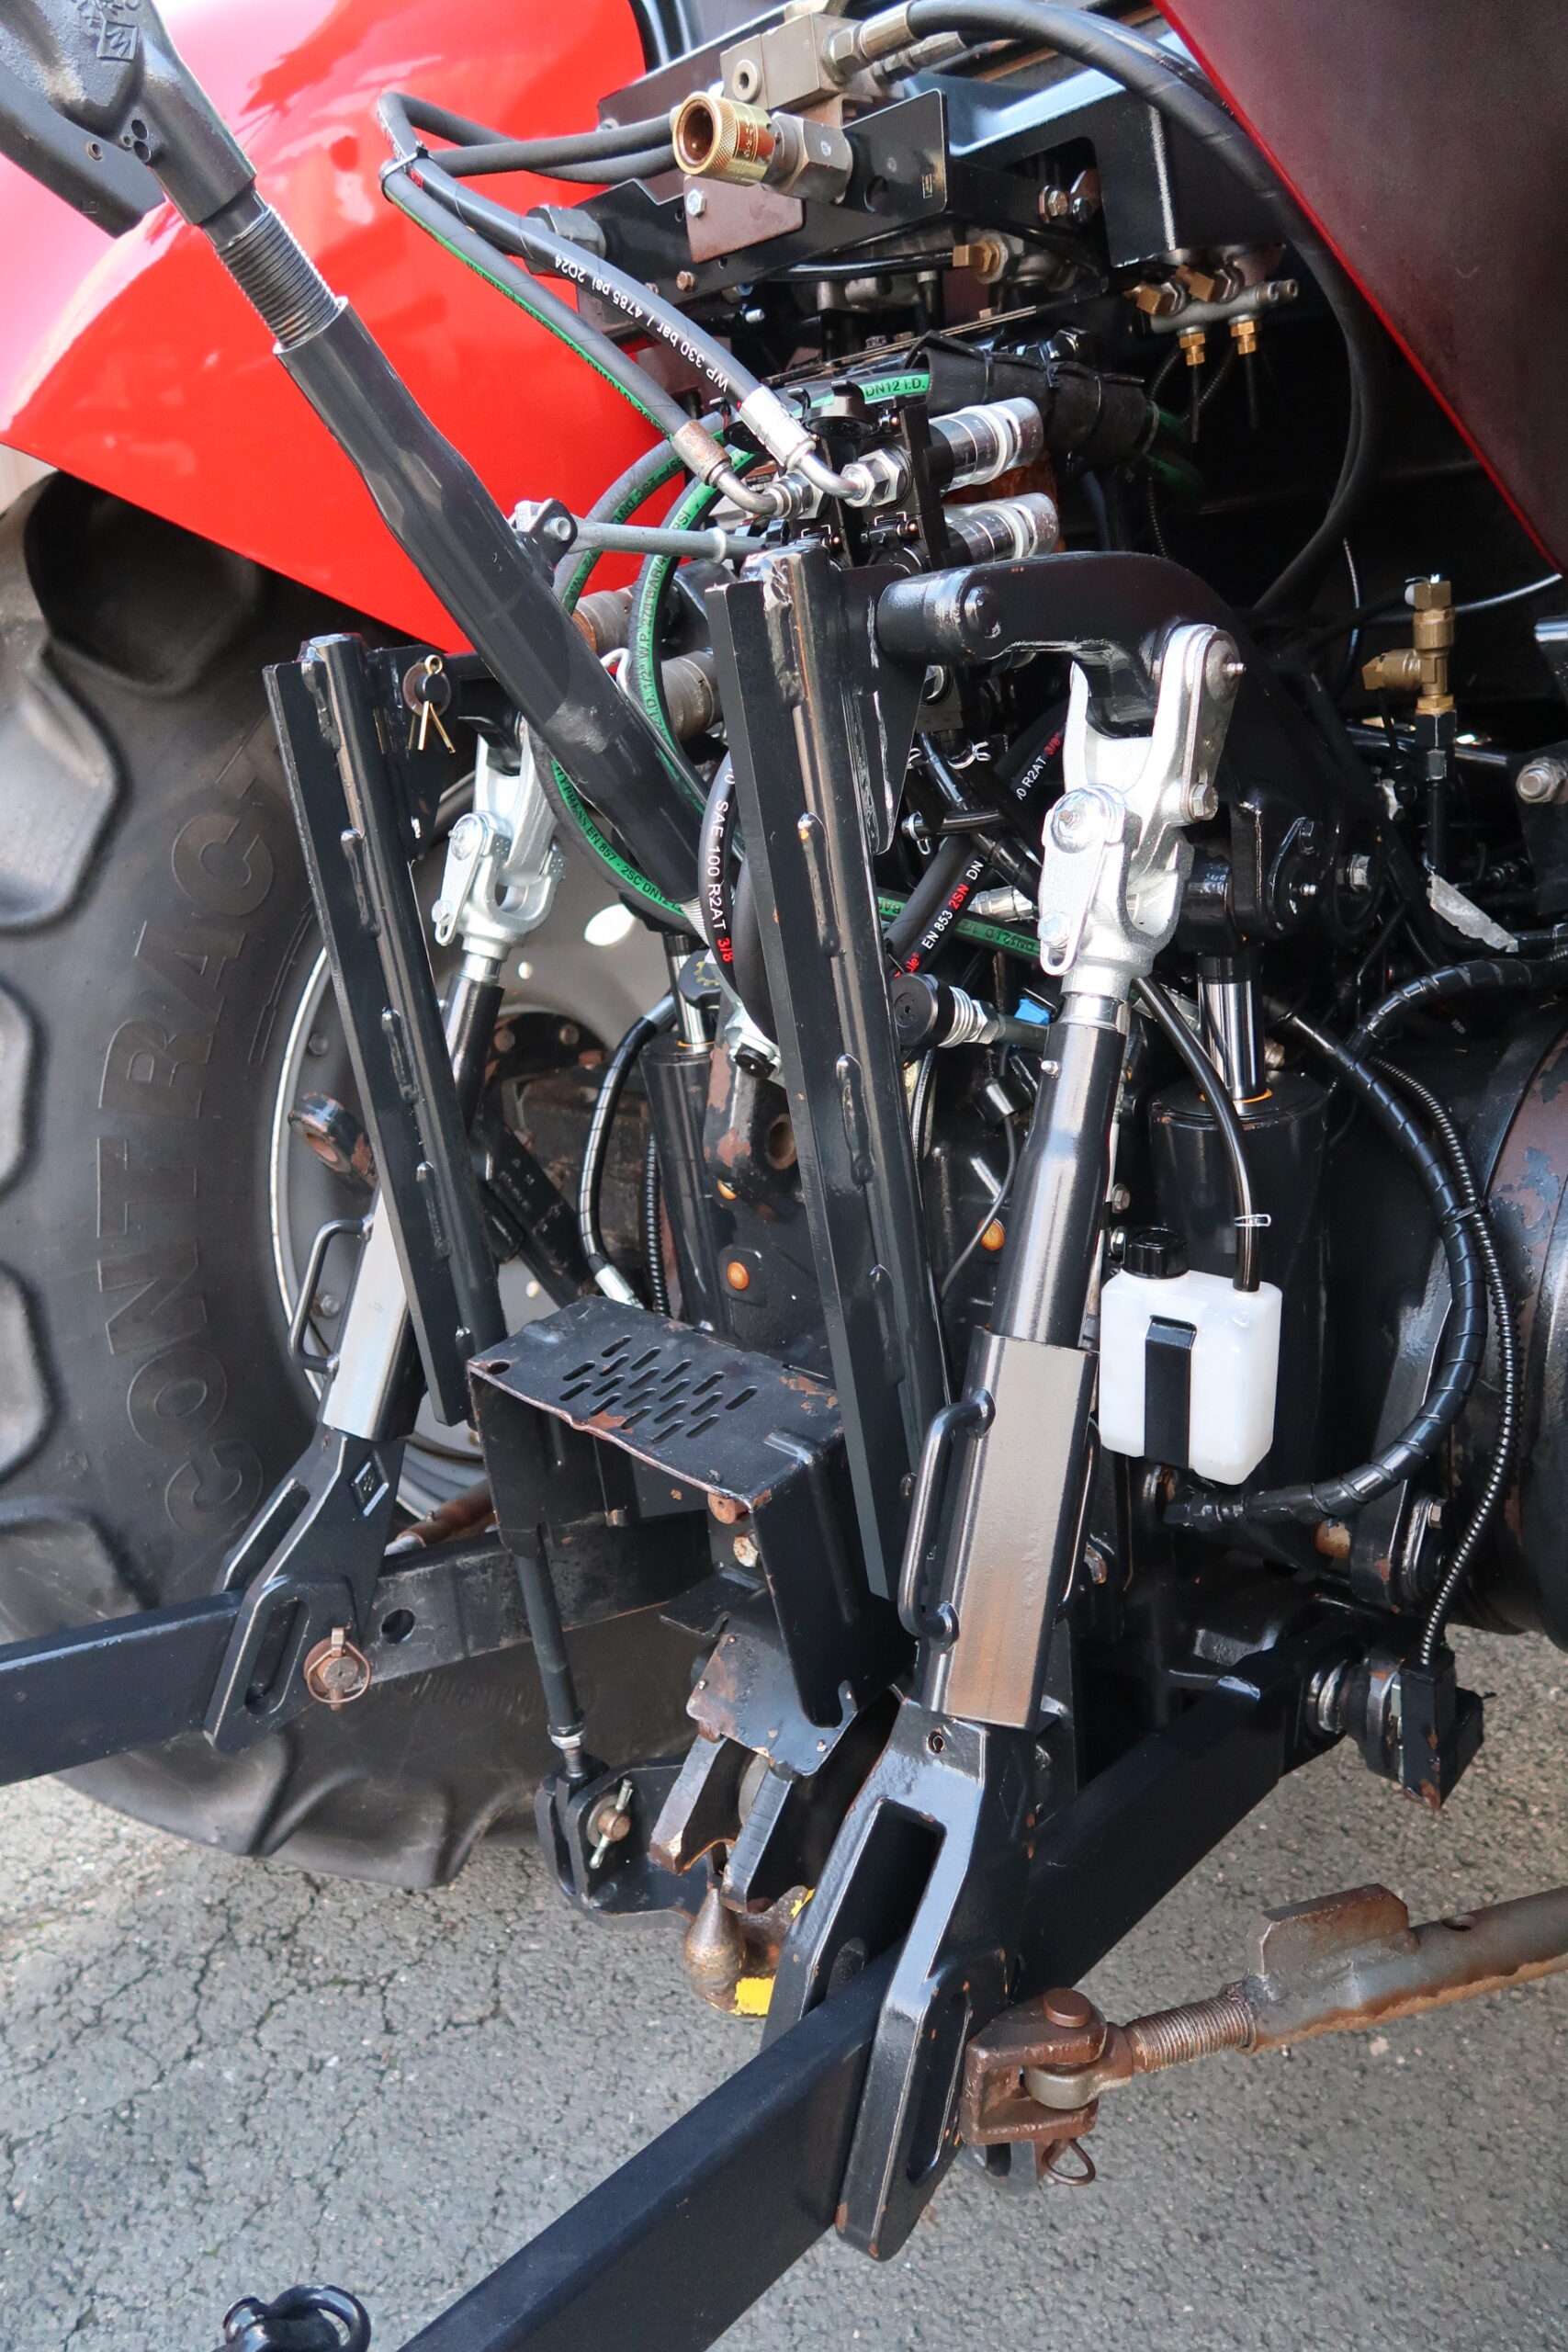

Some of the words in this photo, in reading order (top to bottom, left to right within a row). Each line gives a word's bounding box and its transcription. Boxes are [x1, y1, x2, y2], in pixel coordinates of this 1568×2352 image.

[554, 254, 588, 283] 2Q24
[591, 277, 612, 295] psi
[612, 290, 644, 319] 4785
[656, 325, 680, 347] bar
[680, 343, 705, 368] 330
[705, 368, 729, 392] WP
[864, 379, 900, 397] DN12
[903, 378, 926, 390] I.D.
[1021, 755, 1047, 788] R2AT
[710, 800, 729, 838] SAE
[586, 826, 602, 845] EN
[599, 843, 617, 862] 857
[621, 865, 643, 886] 2SC
[707, 845, 721, 876] 100
[707, 883, 727, 930] R2AT
[921, 929, 940, 950] EN
[934, 910, 954, 933] 853
[948, 883, 970, 911] 2SN
[966, 860, 985, 881] DN
